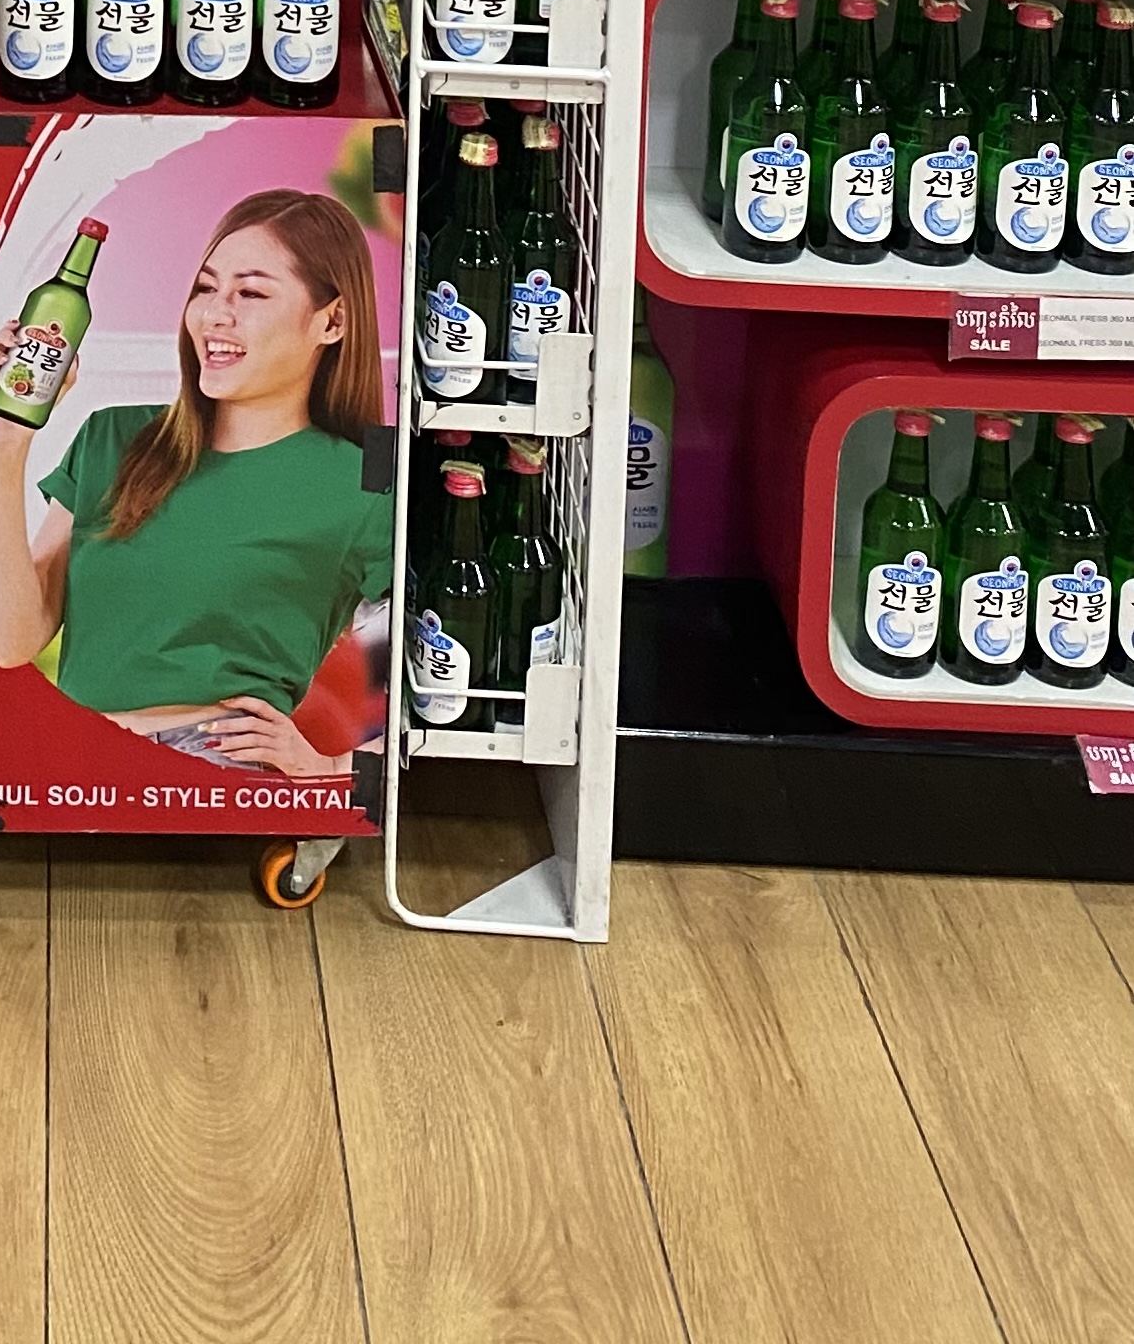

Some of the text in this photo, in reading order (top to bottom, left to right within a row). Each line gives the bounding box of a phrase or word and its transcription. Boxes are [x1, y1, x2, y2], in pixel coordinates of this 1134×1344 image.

[95, 2, 156, 34] 선물
[186, 0, 247, 33] 선물
[273, 3, 334, 36] 선물
[748, 165, 807, 196] 선물
[845, 166, 895, 197] 선물
[922, 169, 977, 199] 선물
[1011, 176, 1066, 207] 선물
[15, 338, 64, 373] 선물
[969, 339, 1011, 352] SALE
[877, 581, 938, 614] 선물
[973, 588, 1028, 619] 선물
[1048, 591, 1108, 624] 선물
[47, 785, 118, 808] SOJU
[142, 786, 226, 808] STYLE
[234, 786, 366, 810] COCKTAI
